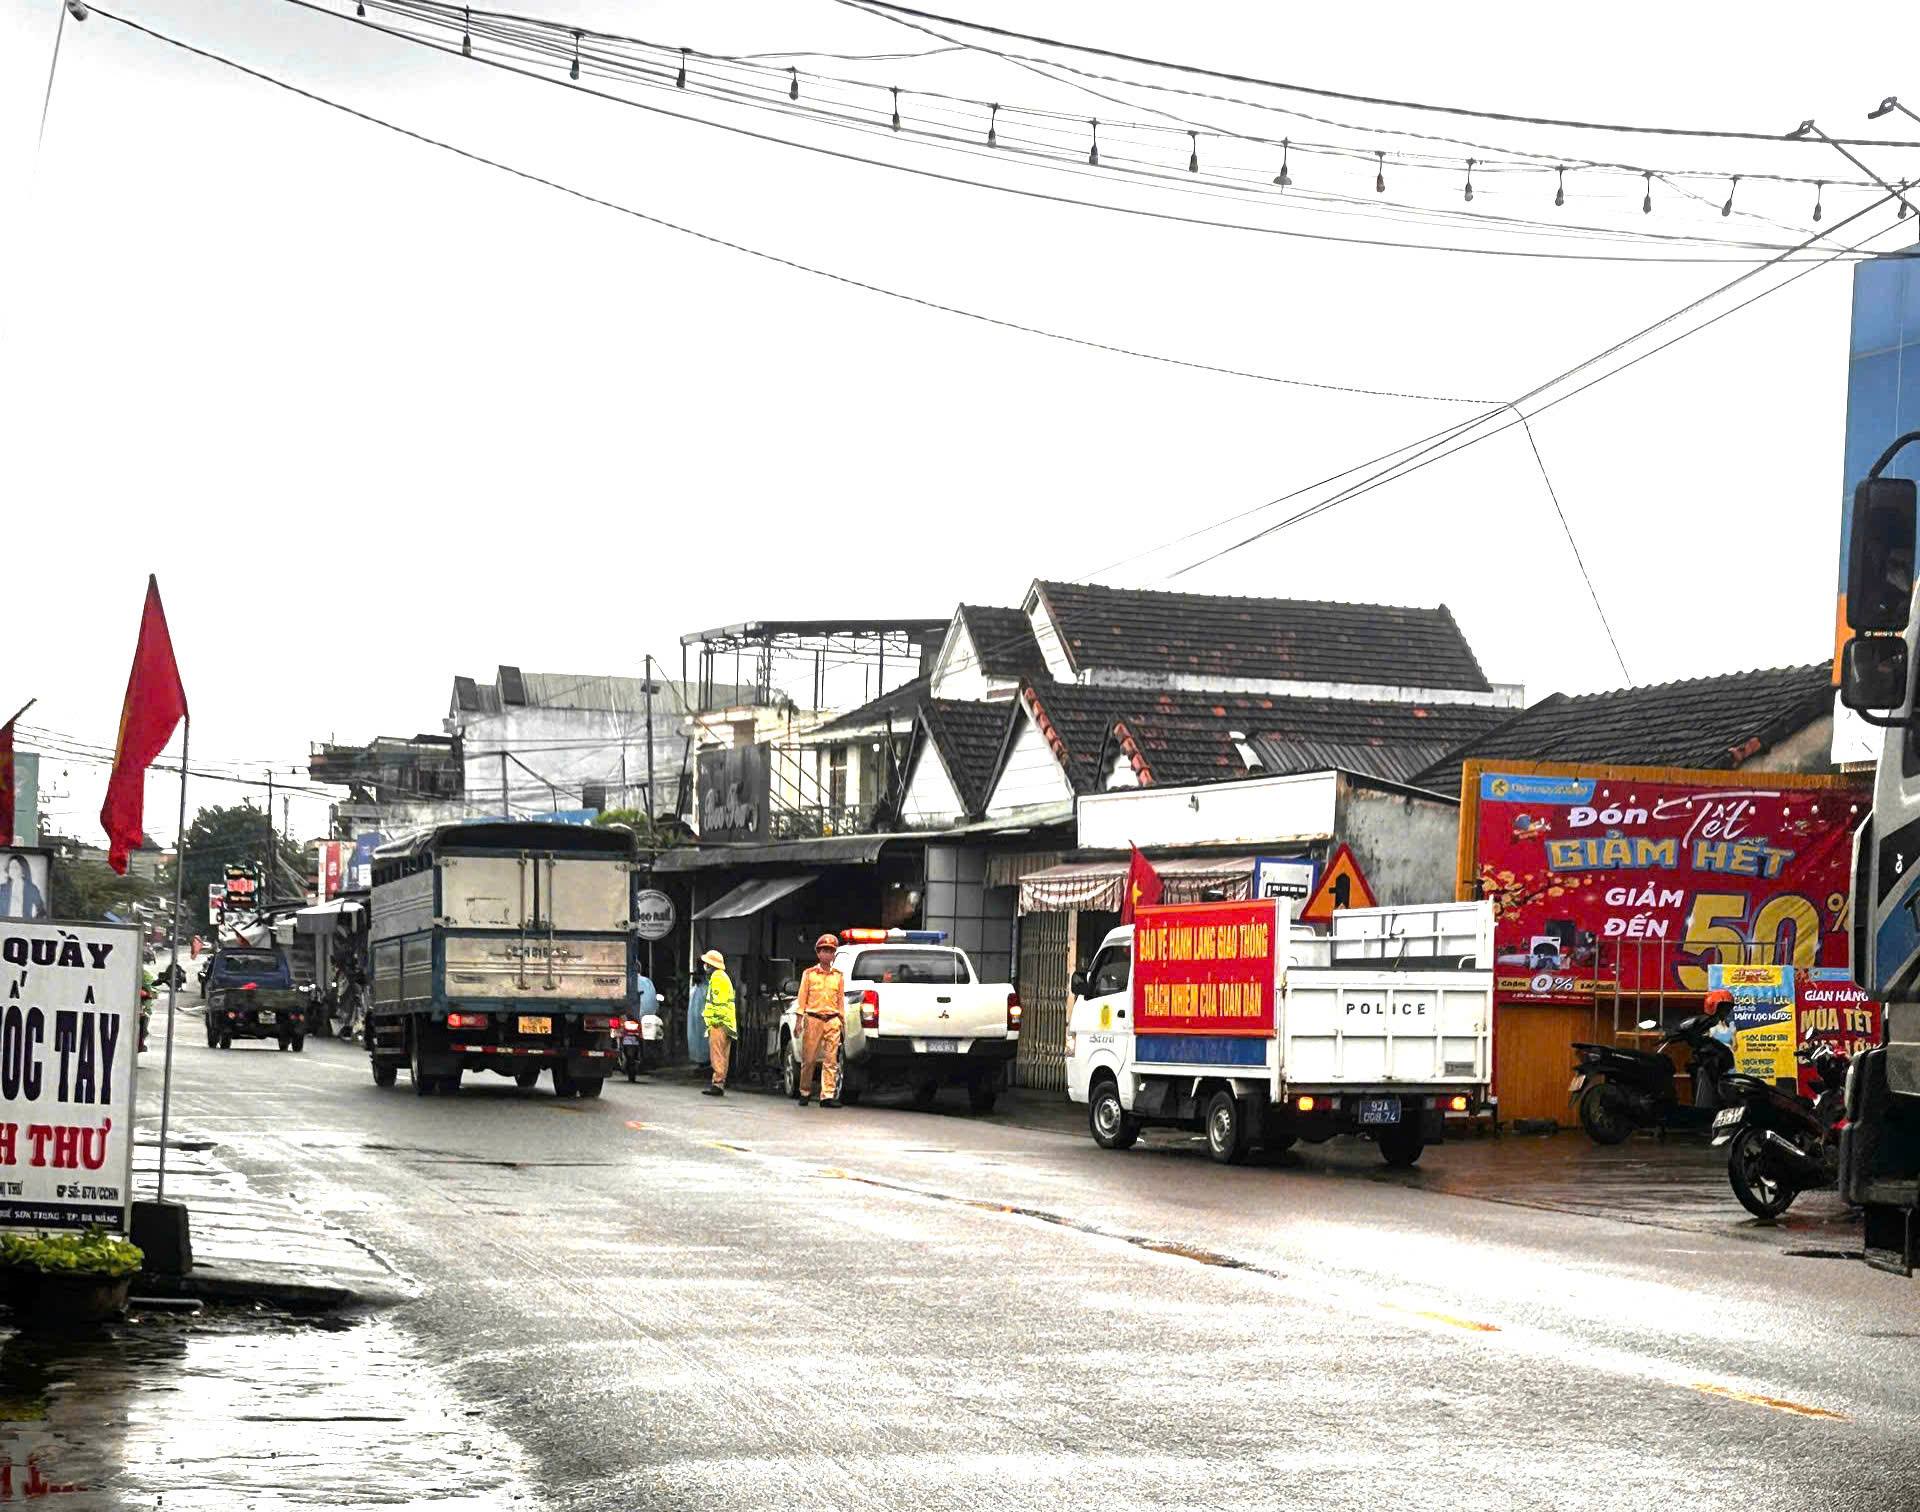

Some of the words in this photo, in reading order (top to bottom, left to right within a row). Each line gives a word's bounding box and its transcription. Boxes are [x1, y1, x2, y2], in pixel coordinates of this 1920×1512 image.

[1567, 802, 1648, 828] Đón
[1652, 791, 1781, 849] Tết
[1548, 831, 1676, 870] GIẢM
[1693, 837, 1793, 878] HẾT
[1605, 882, 1684, 907] GIẢM
[1194, 926, 1216, 960] LANG
[1217, 924, 1238, 959] GIAO
[1239, 916, 1268, 959] THÔNG
[1604, 912, 1669, 938] ĐẾN
[3, 929, 113, 969] QUẦY
[1531, 974, 1574, 993] 0%
[1805, 990, 1833, 1001] GIAN
[1346, 1003, 1426, 1015] POLICE
[1800, 1005, 1840, 1033] MÙA
[1843, 1002, 1873, 1034] TẾT
[55, 985, 120, 1105] TÂY
[27, 1117, 112, 1170] THƯ
